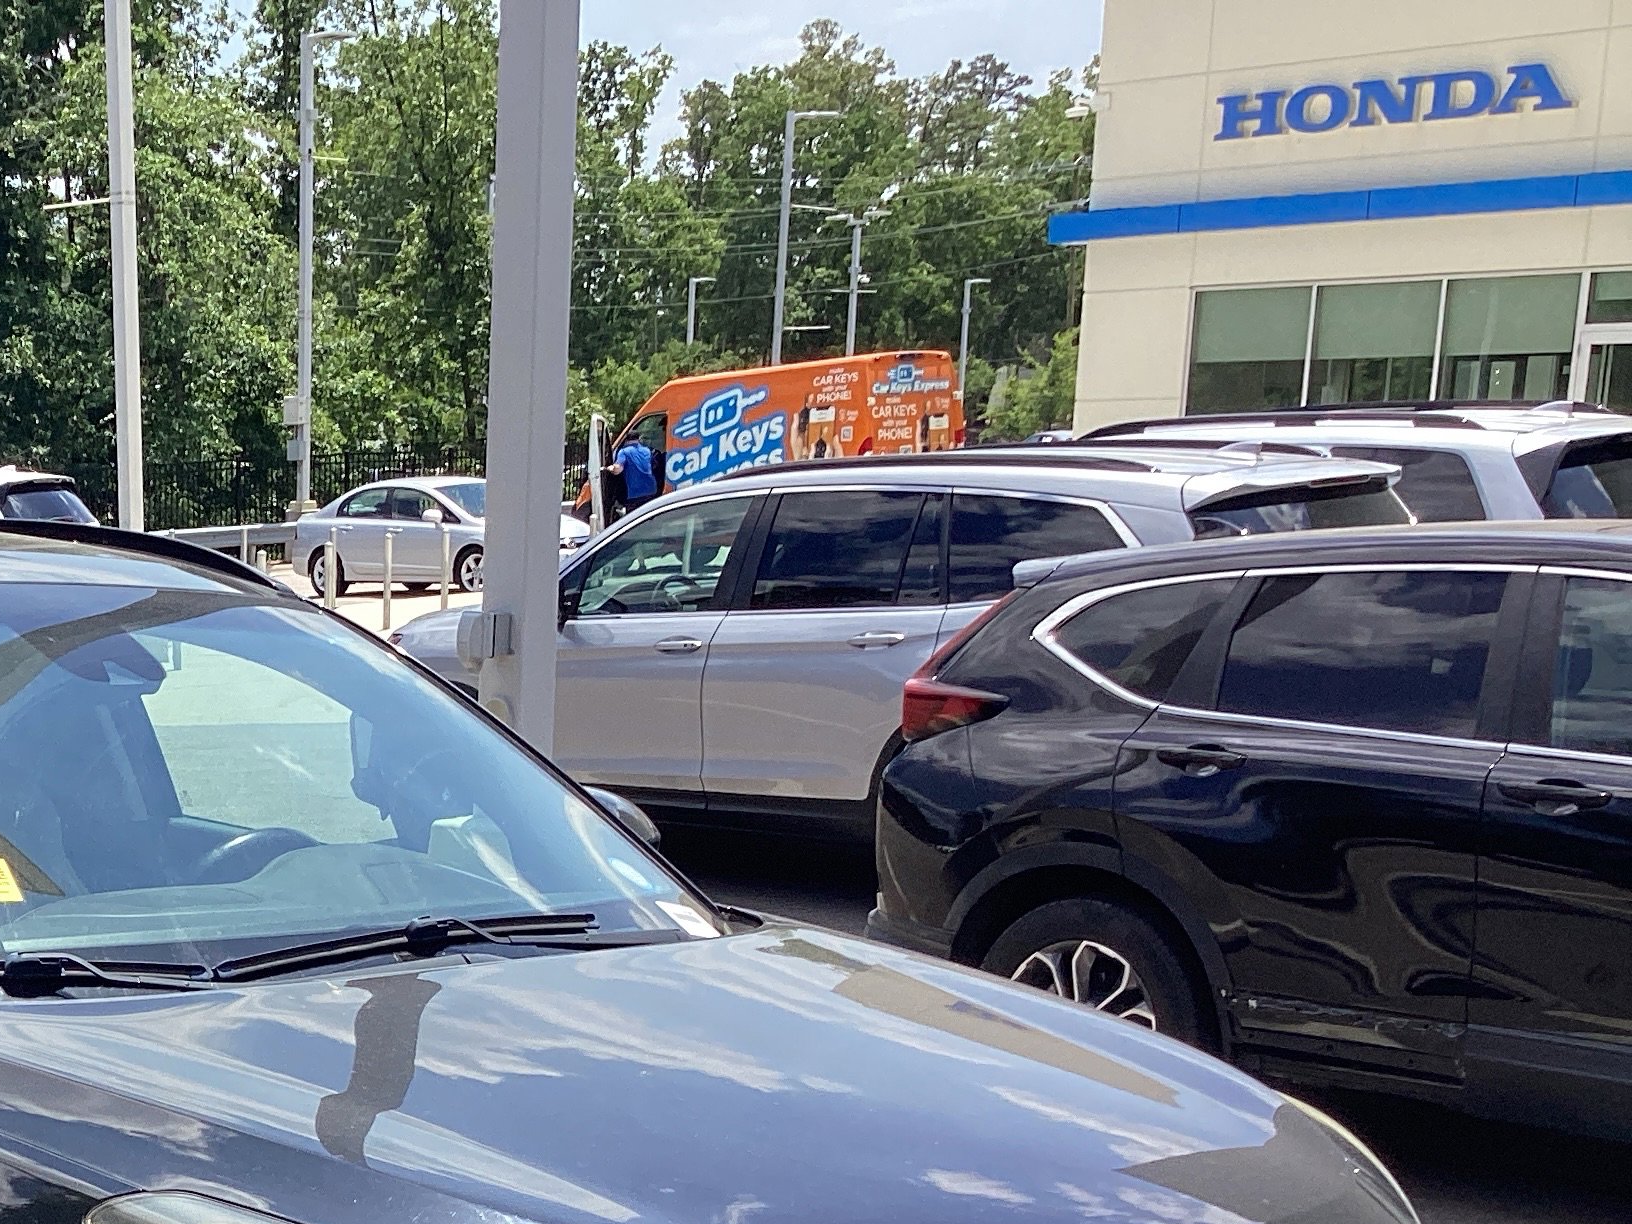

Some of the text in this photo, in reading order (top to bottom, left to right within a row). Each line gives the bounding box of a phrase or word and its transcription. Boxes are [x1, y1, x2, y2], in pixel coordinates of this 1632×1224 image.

[1214, 64, 1572, 141] HONDA
[812, 371, 859, 387] CAR KEYS
[873, 380, 950, 394] Car Keys Express
[816, 390, 852, 404] PHONE!
[871, 405, 892, 418] CAR
[893, 403, 917, 417] KEYS
[878, 426, 913, 441] PHONE!
[665, 443, 713, 481] Car
[718, 415, 784, 463] Keys
